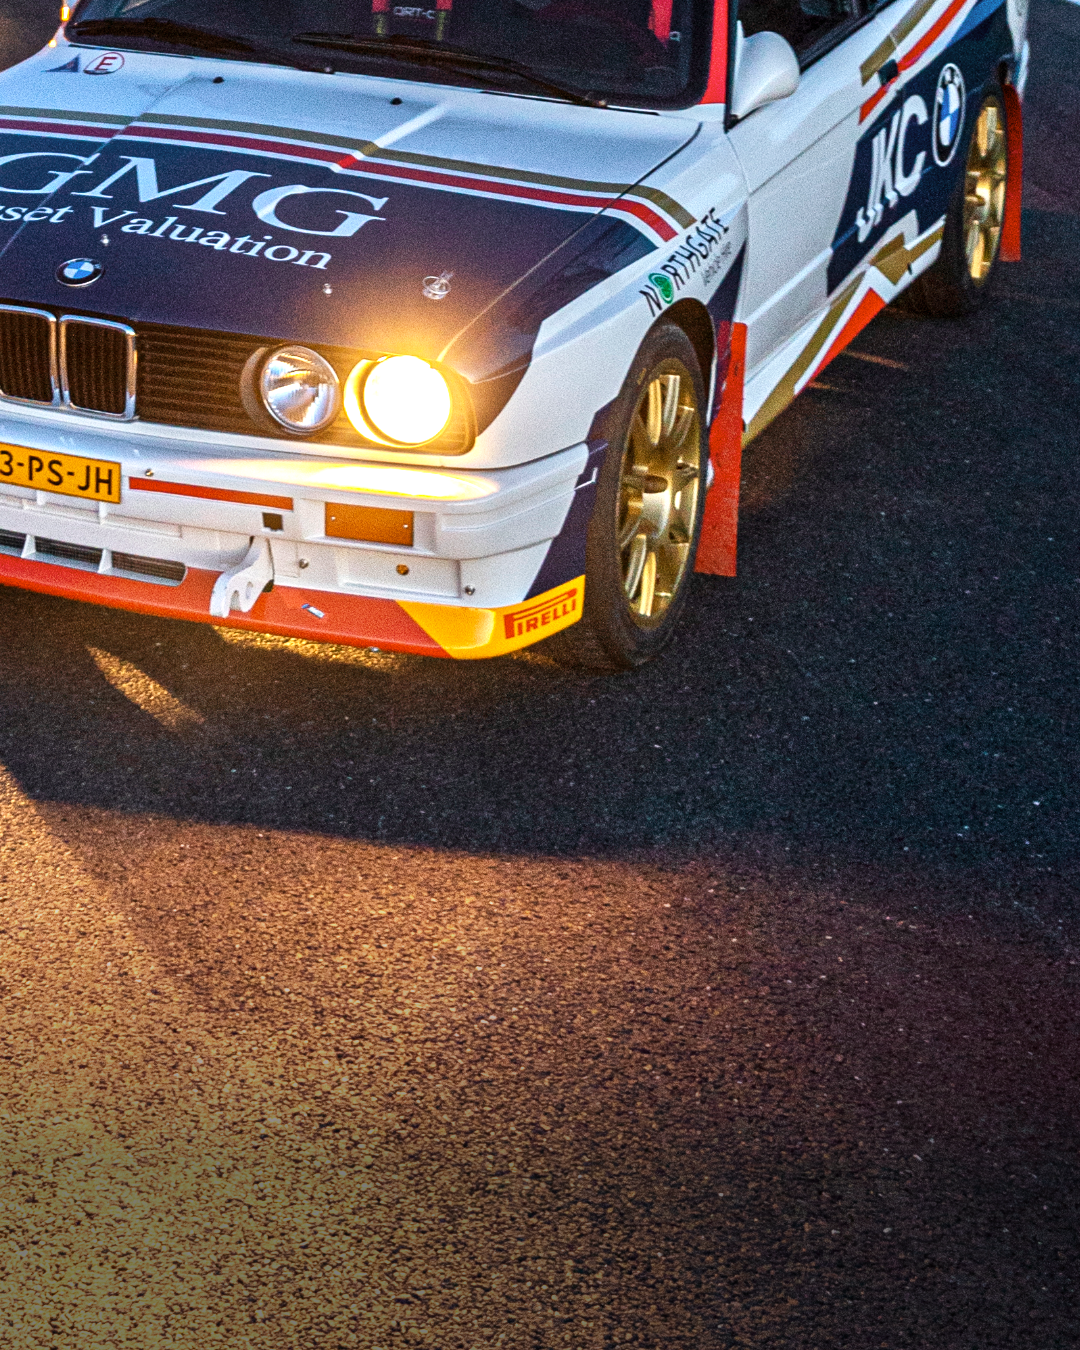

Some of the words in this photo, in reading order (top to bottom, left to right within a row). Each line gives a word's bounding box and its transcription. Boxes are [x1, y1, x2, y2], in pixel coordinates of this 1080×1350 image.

[94, 56, 118, 71] E
[856, 94, 928, 243] JKC
[89, 206, 333, 270] Valuation
[503, 588, 577, 640] PIRELLI
